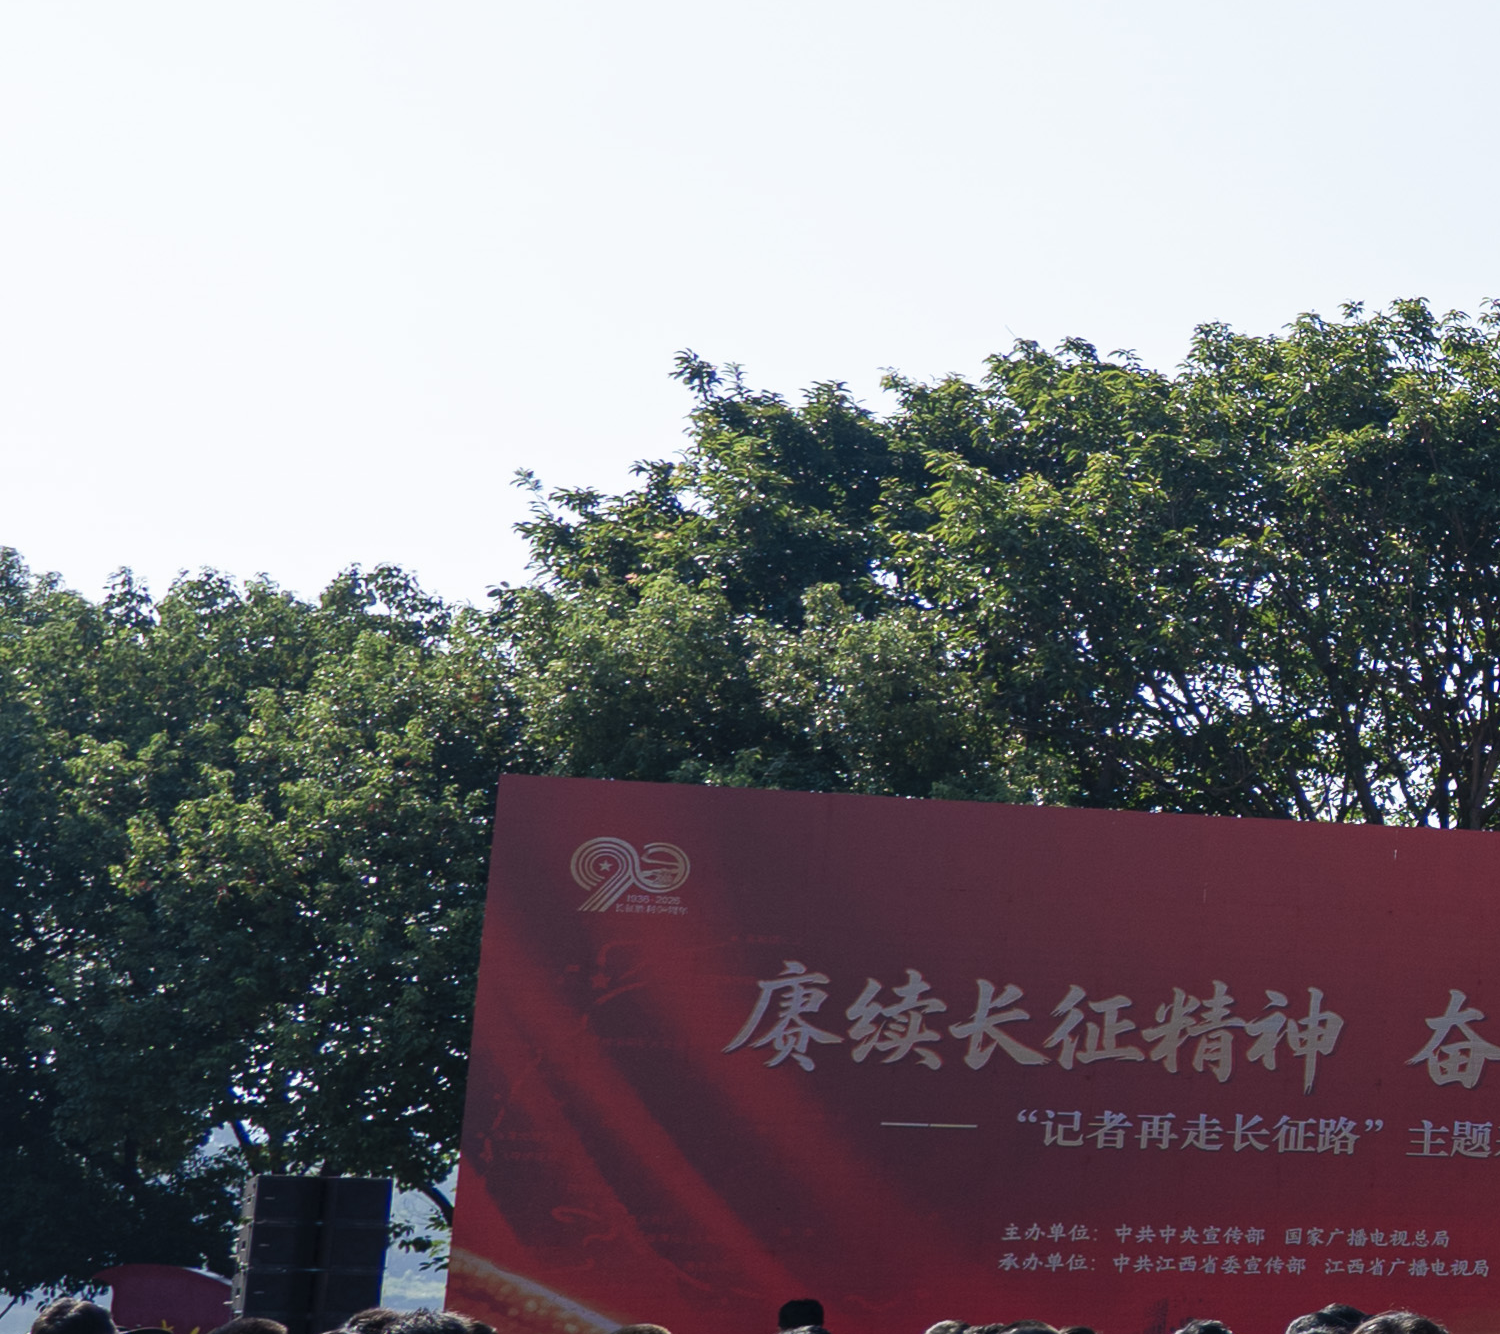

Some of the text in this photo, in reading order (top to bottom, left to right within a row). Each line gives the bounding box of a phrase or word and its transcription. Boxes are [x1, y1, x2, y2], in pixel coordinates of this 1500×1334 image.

[722, 959, 1345, 1095] 赓续长征精神
[1284, 1227, 1450, 1248] 国家广播电视总局
[1324, 1256, 1490, 1278] 江西省广播电视局
